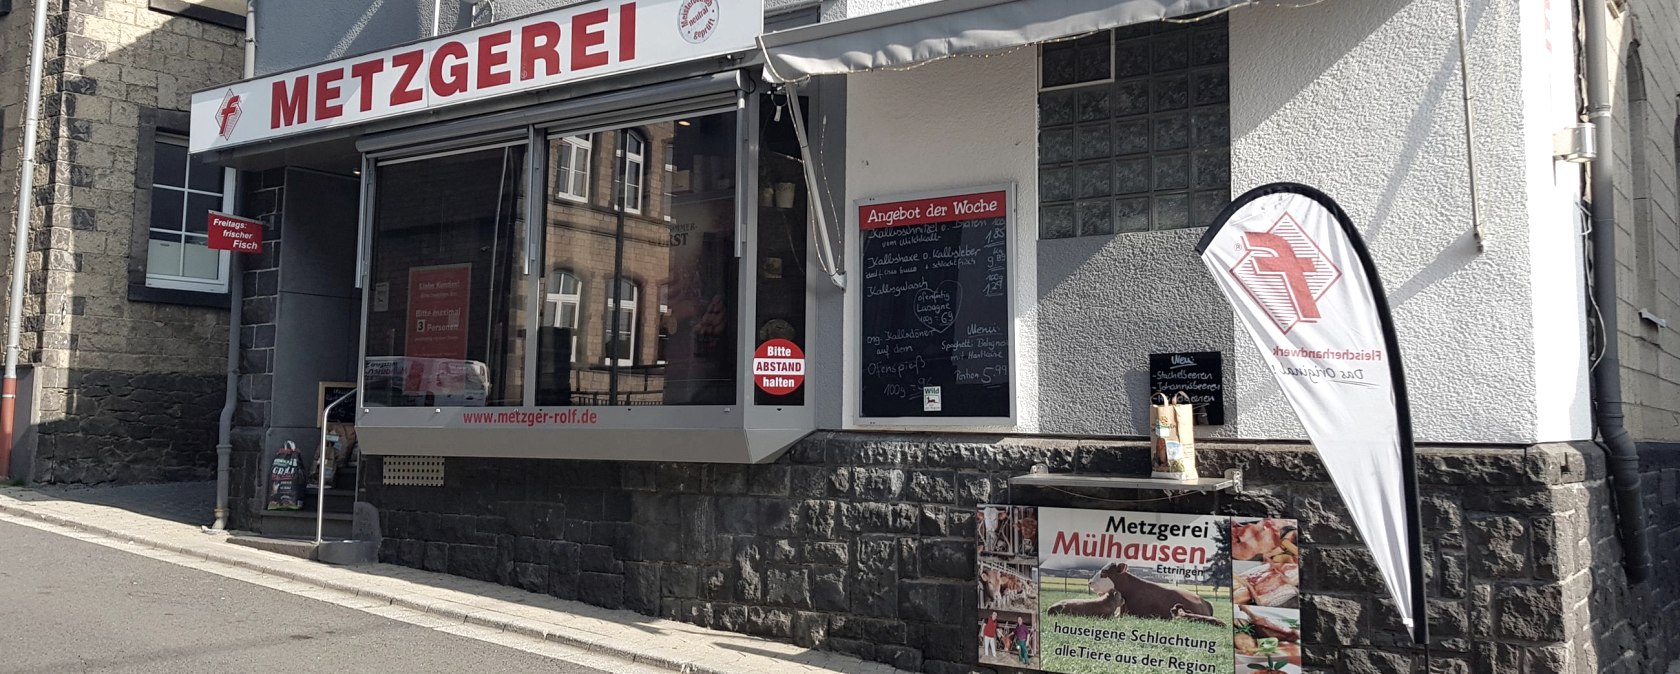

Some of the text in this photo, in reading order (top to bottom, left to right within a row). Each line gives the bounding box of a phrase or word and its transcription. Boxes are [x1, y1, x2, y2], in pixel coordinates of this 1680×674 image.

[270, 1, 636, 130] METZGEREI
[867, 199, 998, 226] Angebot der Woche
[213, 218, 248, 230] Freitags:
[222, 230, 254, 239] frischer
[232, 240, 258, 250] Fisch
[916, 302, 951, 314] Lasagne
[417, 321, 424, 331] 3
[767, 346, 792, 357] Bitte
[876, 345, 913, 360] auf dem
[950, 352, 964, 361] mit
[756, 362, 802, 372] ABSTAND
[954, 369, 980, 381] Portion
[762, 376, 795, 388] halten
[463, 408, 597, 427] www.metzger-rolf.de
[1106, 516, 1209, 540] Metzgerei
[1052, 530, 1207, 565] Mülhausen
[1156, 564, 1204, 578] Ettringen
[1054, 622, 1217, 653] hauseigene Schlachtung
[1115, 653, 1138, 665] aus
[1141, 652, 1166, 667] der
[1168, 656, 1217, 674] Region
